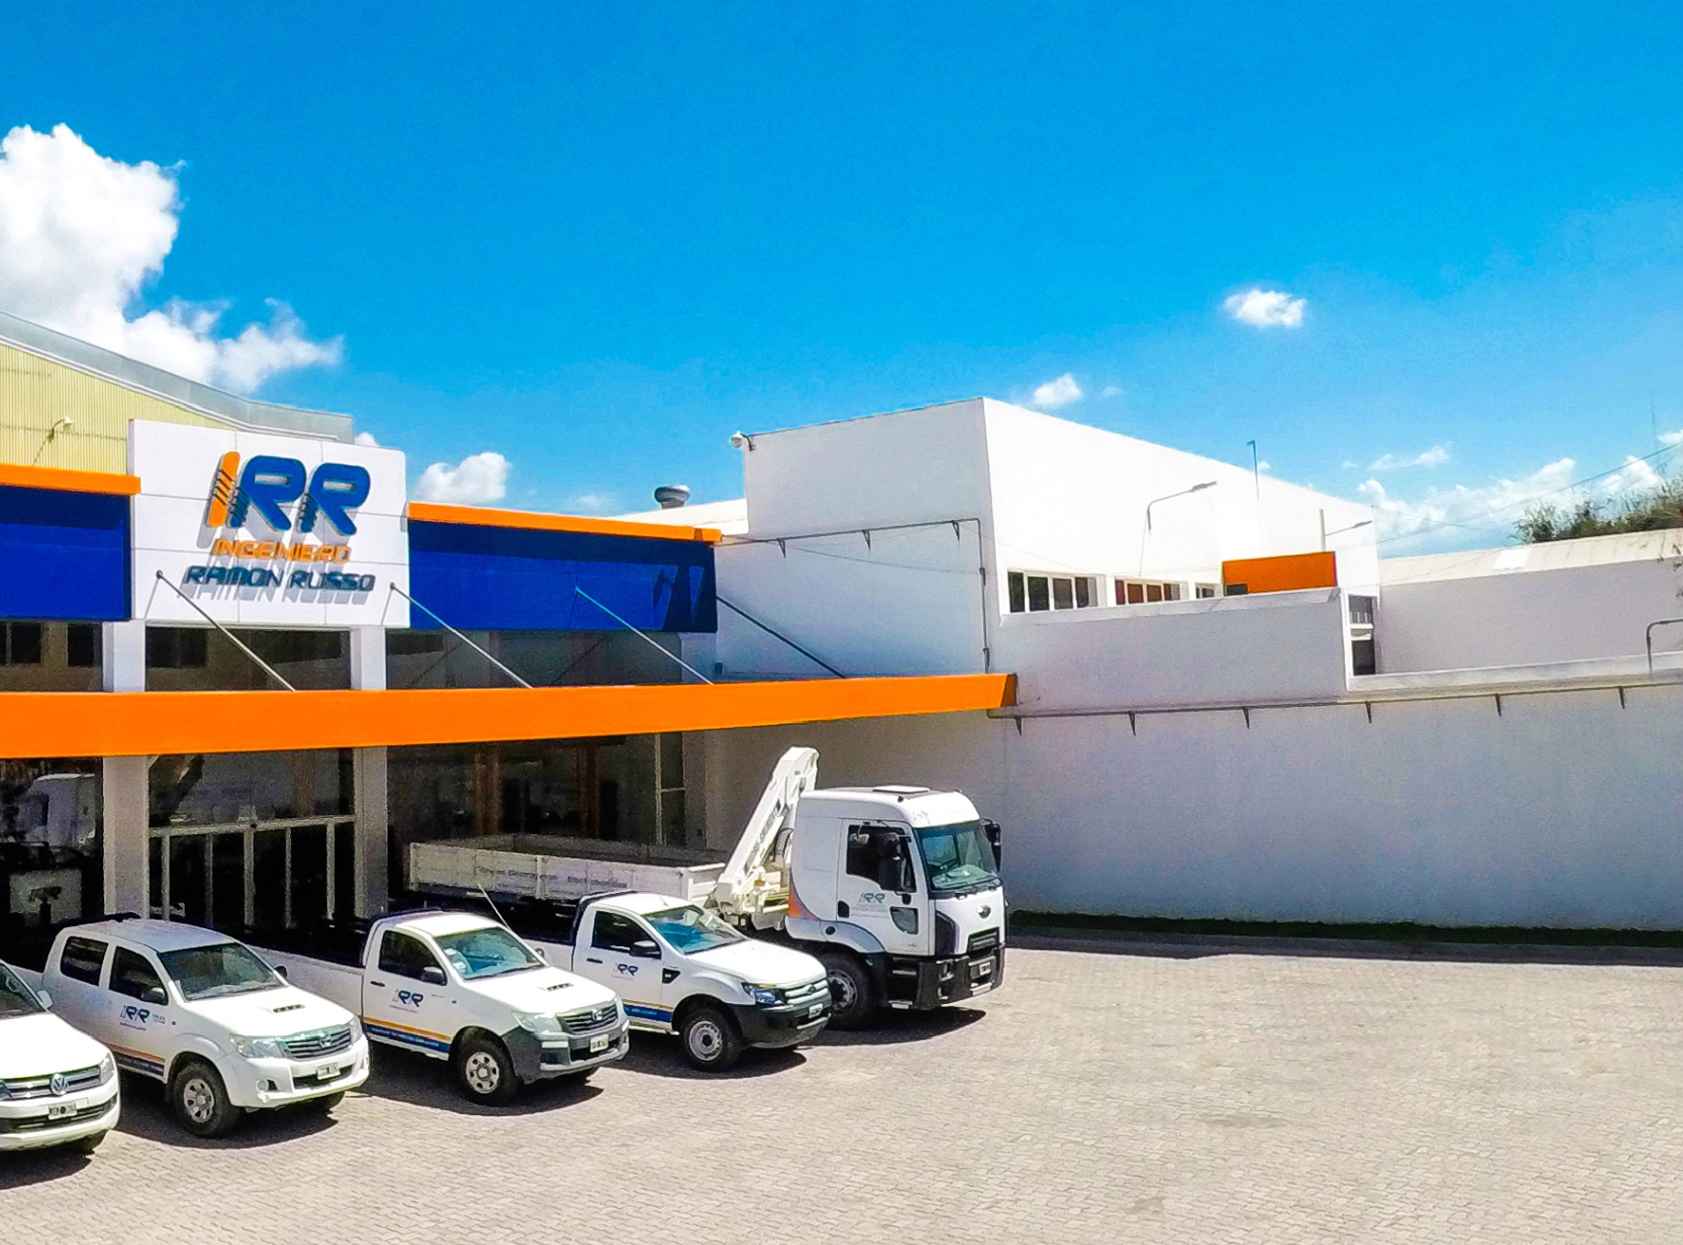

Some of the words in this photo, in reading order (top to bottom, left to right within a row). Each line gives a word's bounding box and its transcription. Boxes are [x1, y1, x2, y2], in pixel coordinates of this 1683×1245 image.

[212, 538, 352, 564] INGENIERO
[183, 565, 284, 589] RAMON
[289, 570, 377, 592] RUSSO
